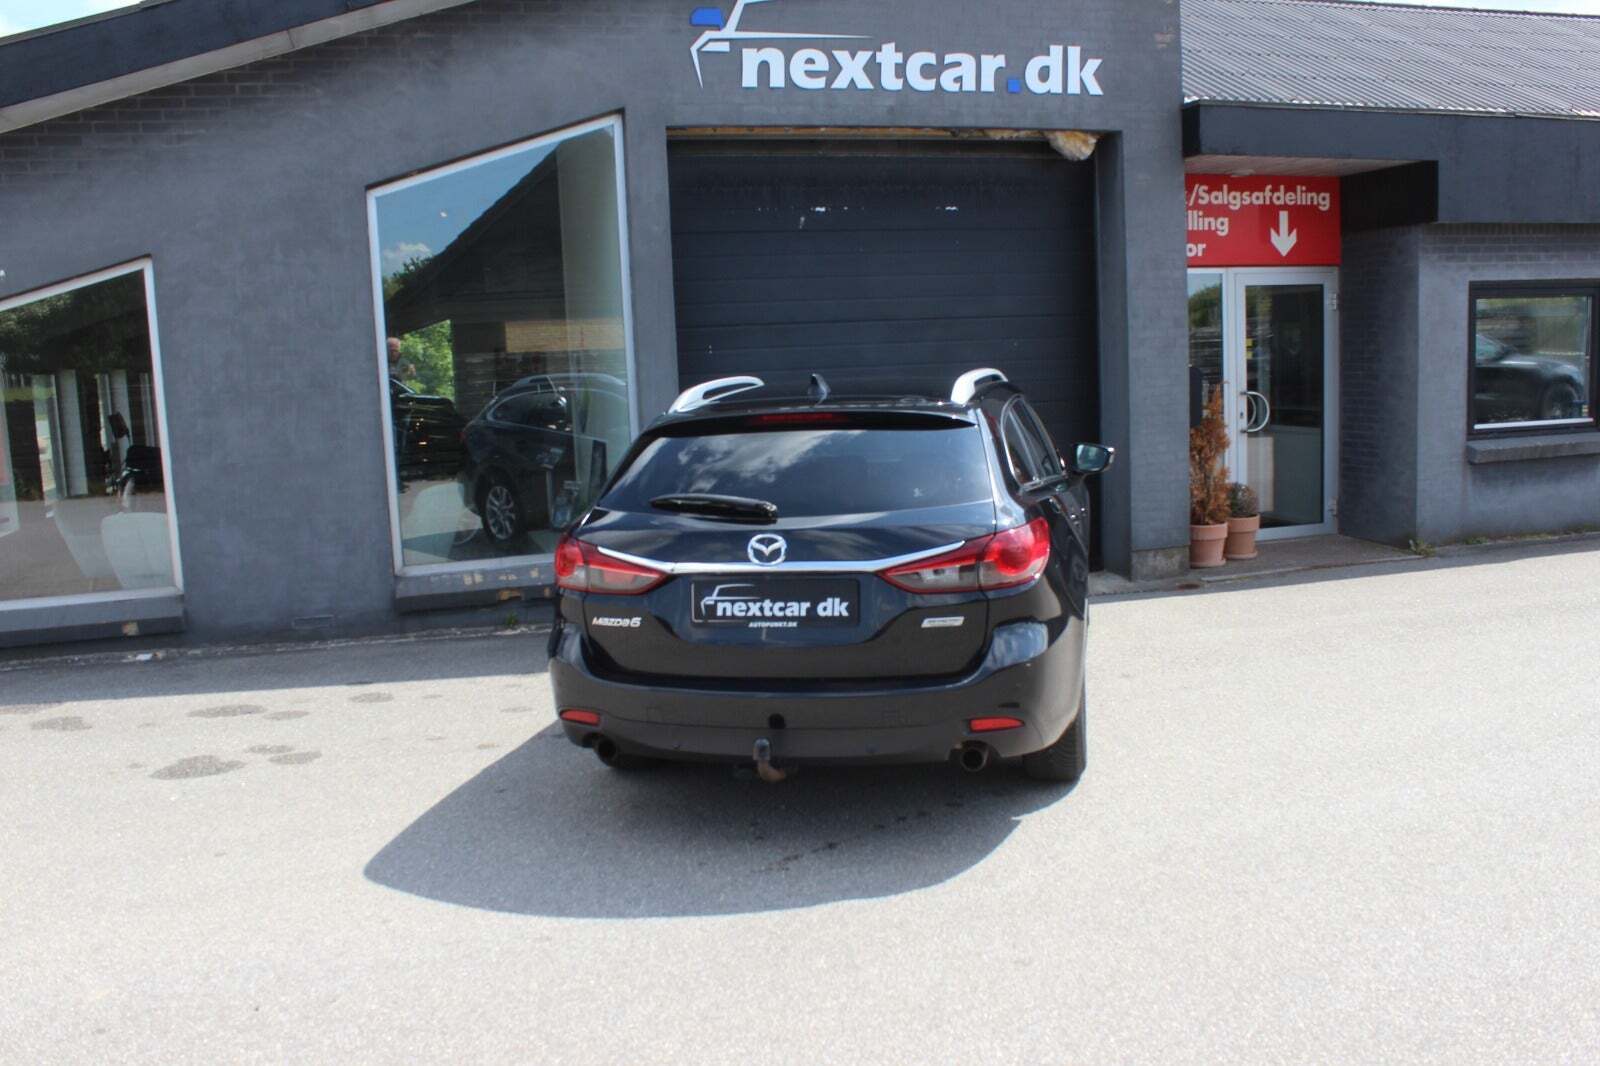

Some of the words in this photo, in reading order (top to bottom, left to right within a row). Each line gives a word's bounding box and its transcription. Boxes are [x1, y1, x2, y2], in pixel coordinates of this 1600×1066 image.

[741, 42, 1104, 96] nextcar.dk
[1185, 183, 1331, 211] /Salgsafdeling
[716, 599, 811, 617] nextcar
